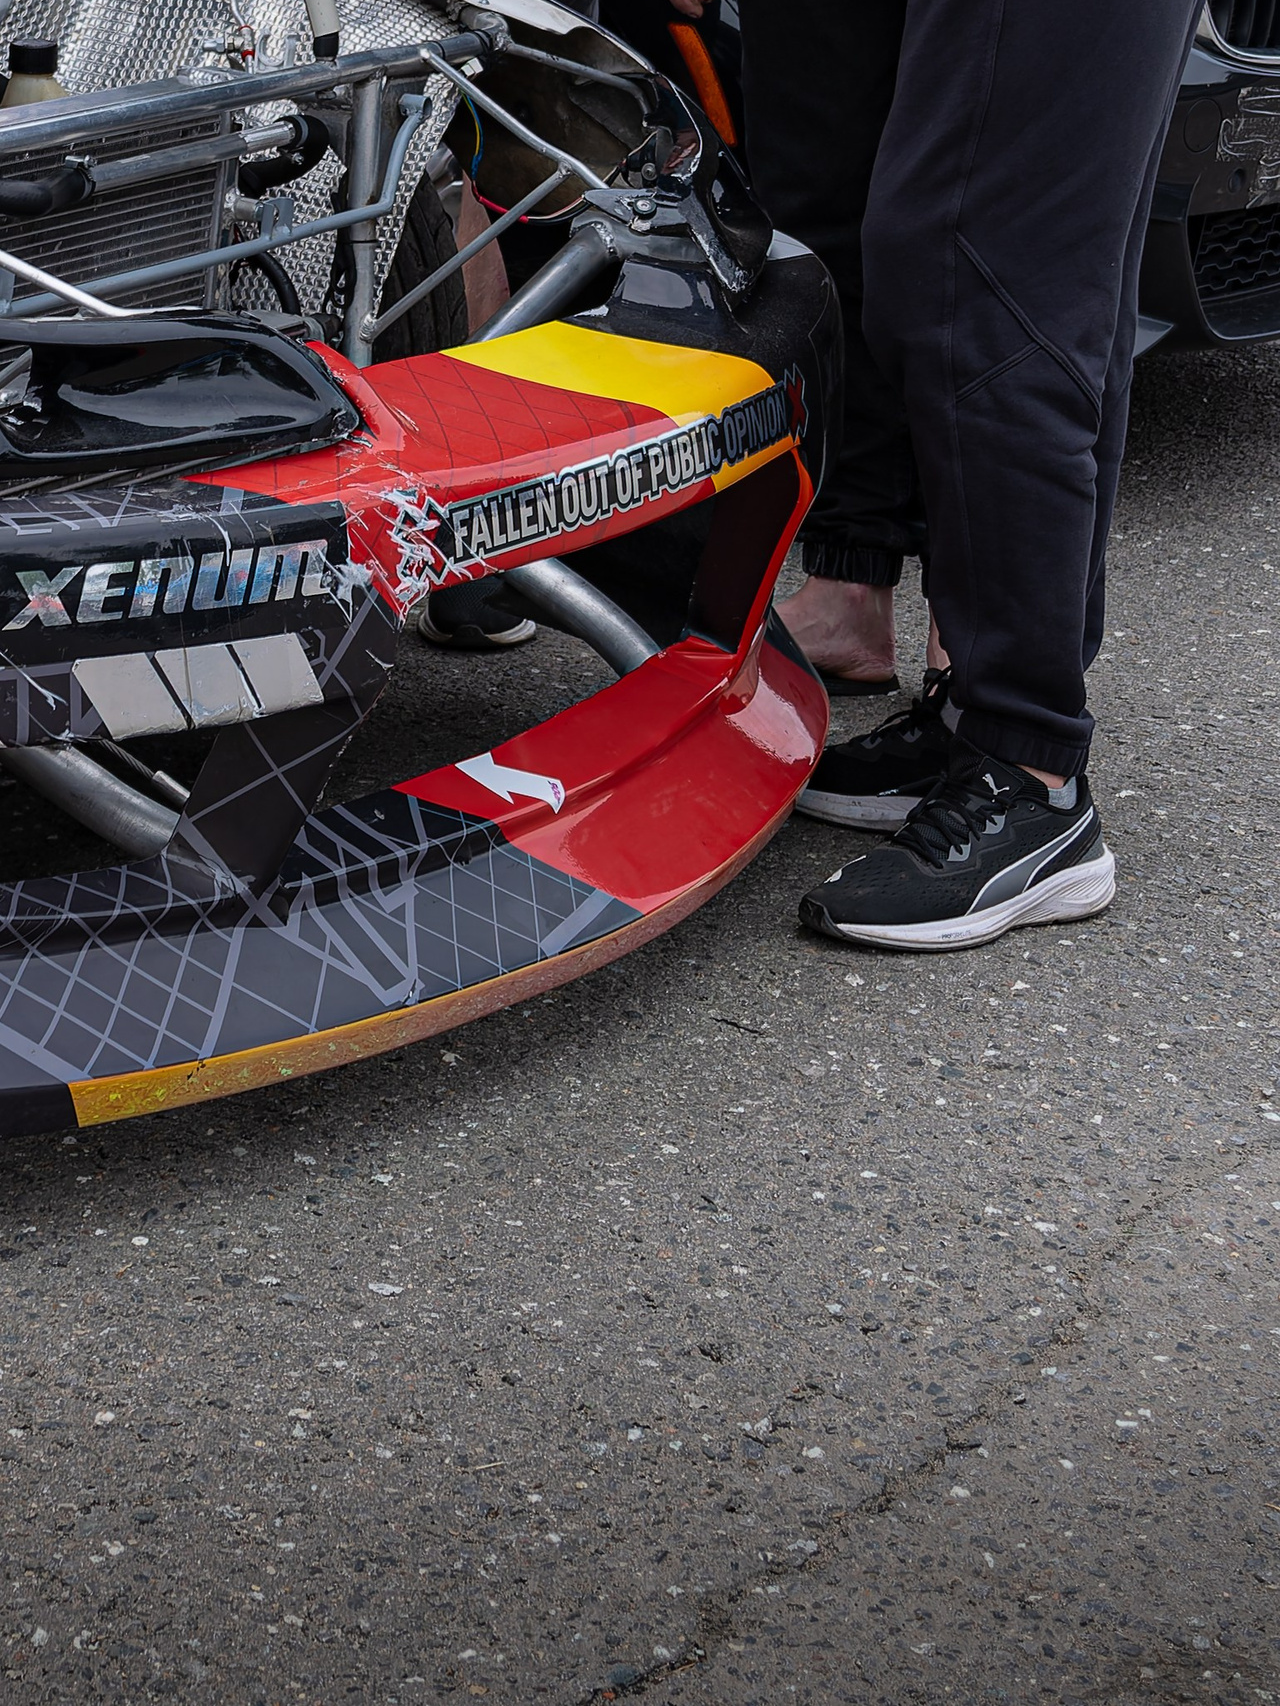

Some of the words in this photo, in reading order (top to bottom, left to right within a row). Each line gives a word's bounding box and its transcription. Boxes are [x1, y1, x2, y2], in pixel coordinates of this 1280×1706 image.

[453, 481, 557, 558] FALLEN
[562, 466, 610, 524] OUT
[617, 450, 644, 506] OF
[650, 421, 722, 492] PUBLIC
[723, 388, 787, 456] OPINION
[1, 539, 333, 631] XENUM
